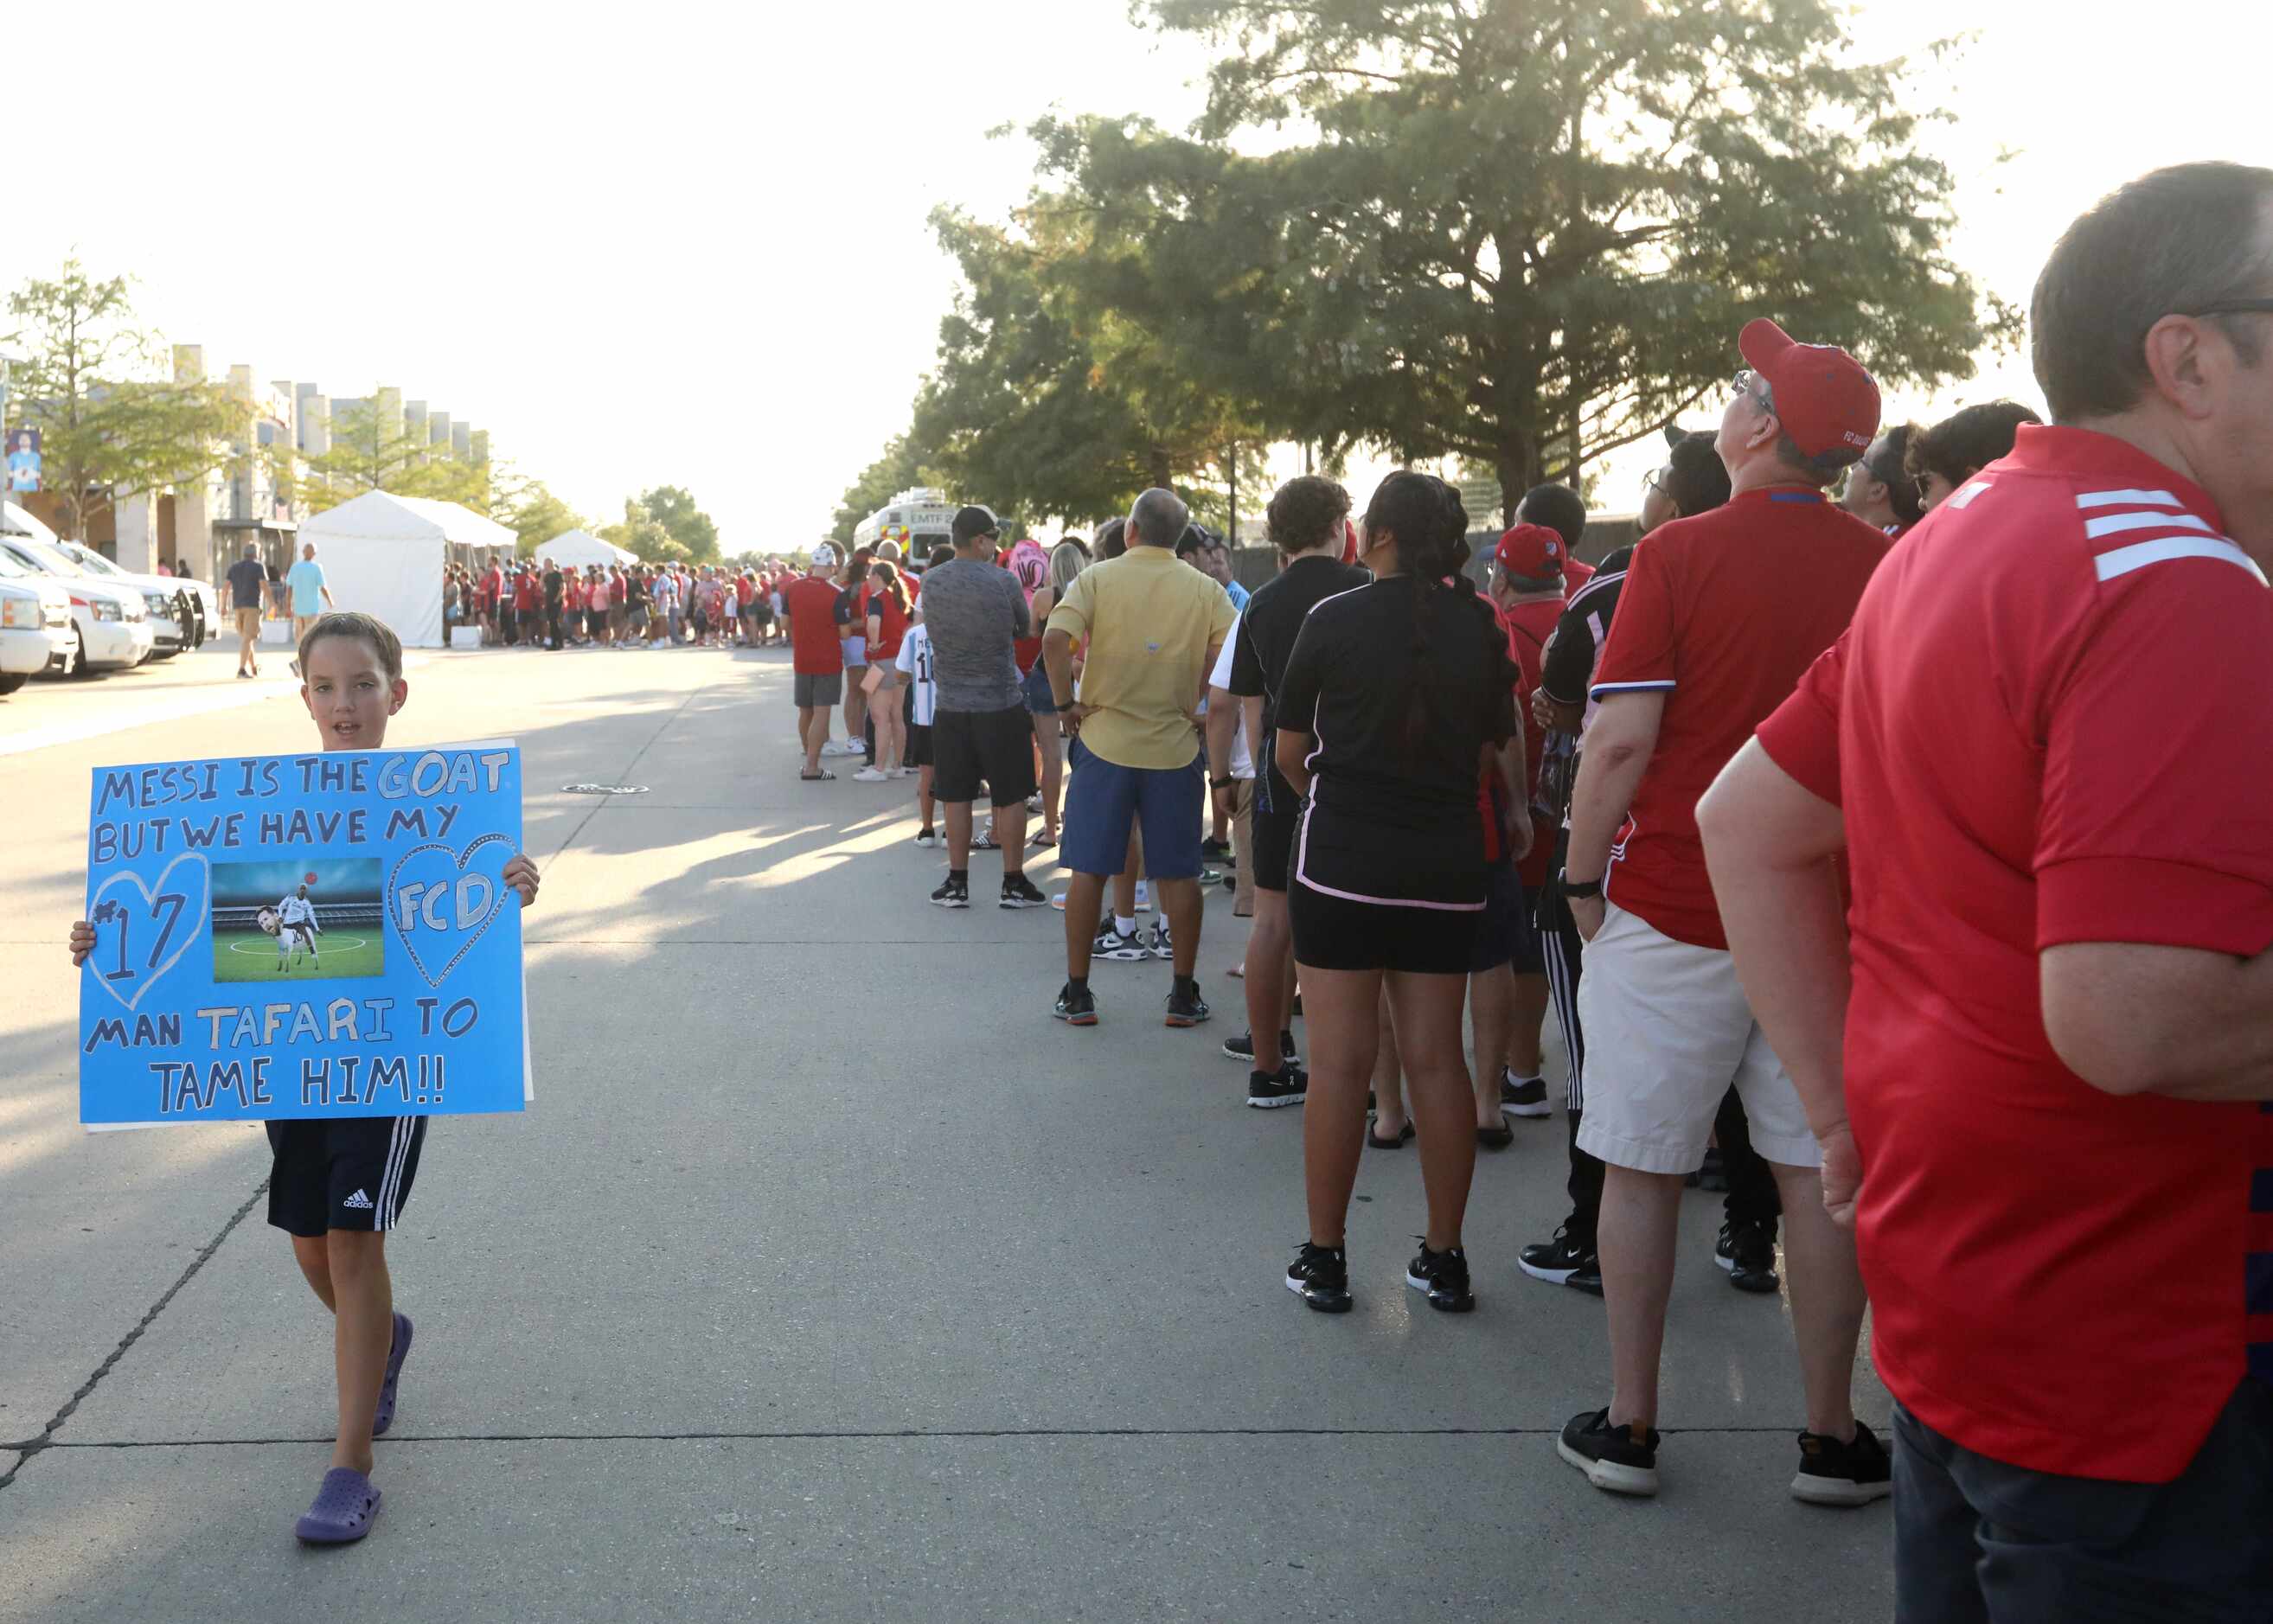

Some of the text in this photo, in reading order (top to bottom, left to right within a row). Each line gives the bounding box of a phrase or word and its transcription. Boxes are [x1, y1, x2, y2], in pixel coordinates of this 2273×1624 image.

[911, 512, 942, 523] EMTF
[97, 750, 510, 815] MESSI IS THE GOAT
[93, 803, 460, 864] BUT WE HAVE MY
[399, 872, 494, 932] FCD
[83, 995, 478, 1054] MAN TAFARI TO
[148, 1054, 445, 1114] TAME HIM!!
[343, 1199, 374, 1209] adidas
